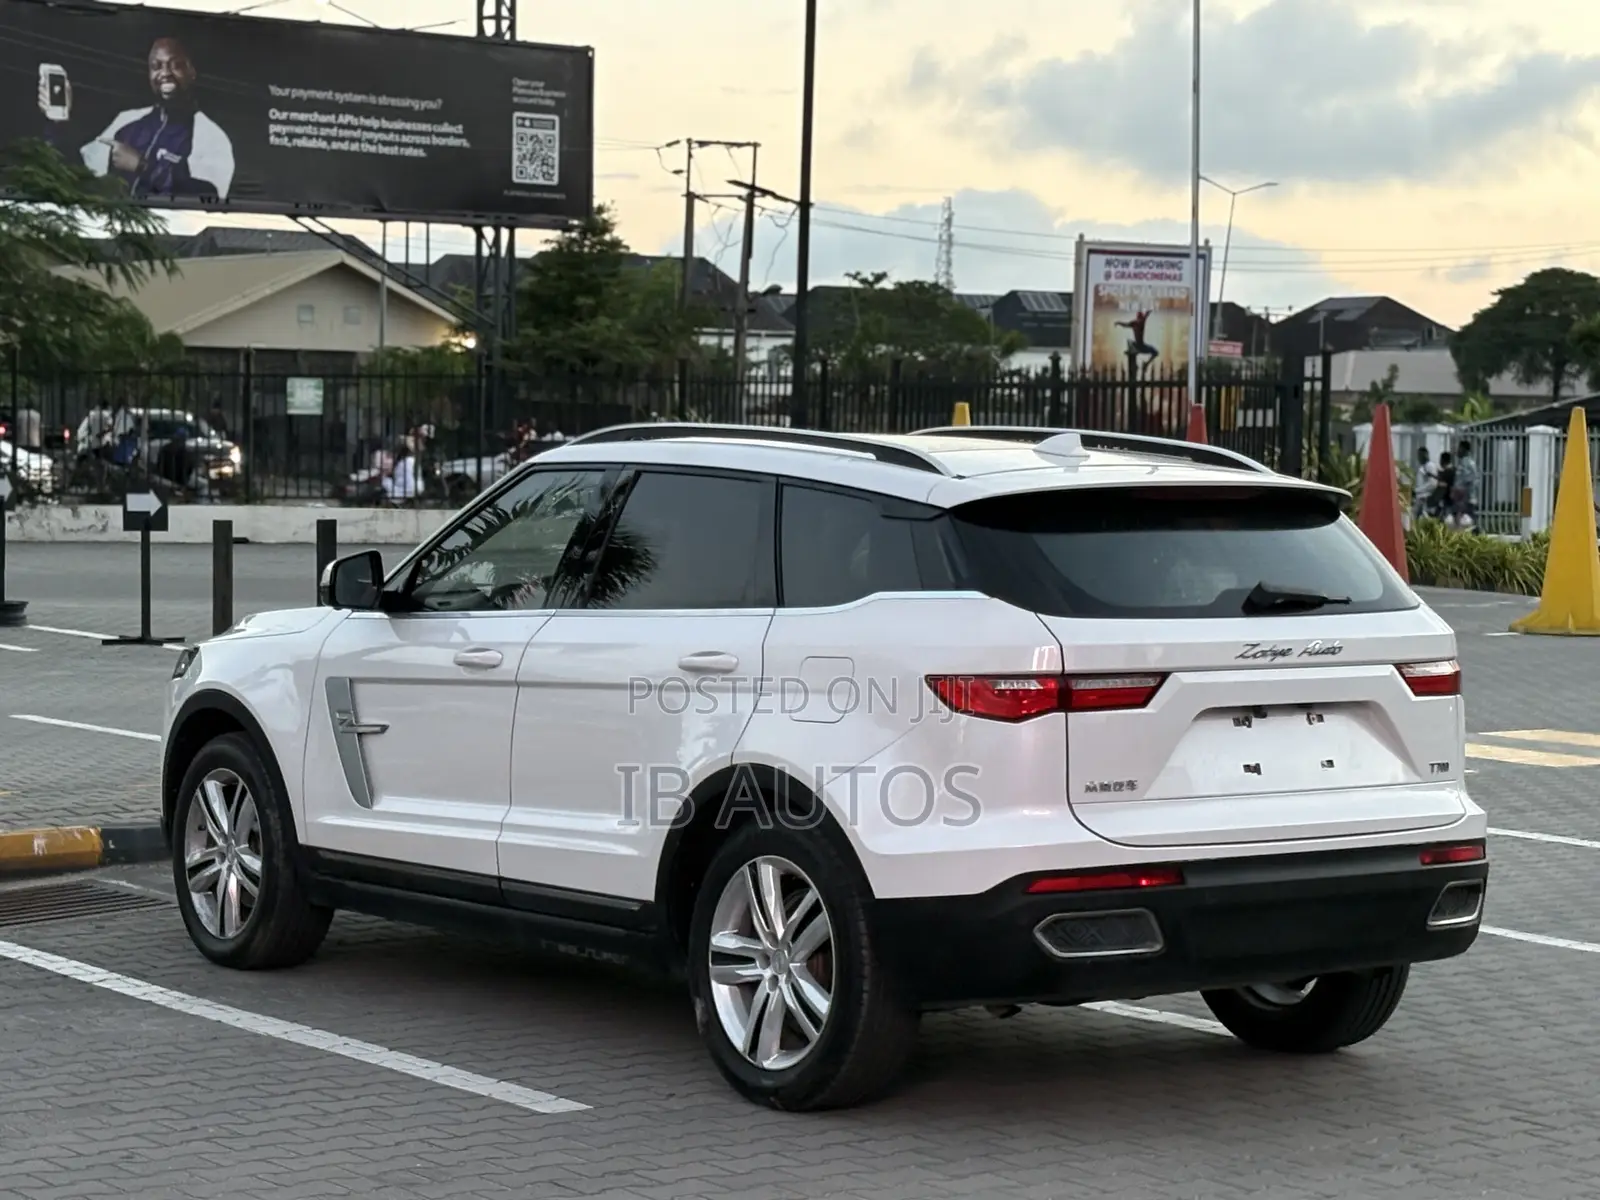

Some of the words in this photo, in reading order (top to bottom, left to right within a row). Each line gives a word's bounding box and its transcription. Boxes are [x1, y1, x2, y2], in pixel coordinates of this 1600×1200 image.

[268, 84, 291, 97] Your
[290, 87, 334, 101] payment
[334, 91, 369, 104] system
[377, 94, 420, 111] stressing
[420, 98, 443, 111] you?
[268, 107, 289, 120] Our
[289, 110, 336, 124] merchant
[360, 115, 380, 130] help
[380, 117, 432, 132] businesses
[432, 121, 464, 134] collect
[269, 123, 319, 137] payments
[319, 125, 338, 137] and
[338, 127, 361, 138] send
[401, 133, 431, 145] across
[330, 139, 349, 151] and
[349, 141, 360, 152] at
[360, 141, 377, 153] the
[377, 142, 399, 155] best
[1104, 258, 1130, 269] NOW
[1134, 260, 1183, 270] SHOWING
[1296, 639, 1344, 658] Auto
